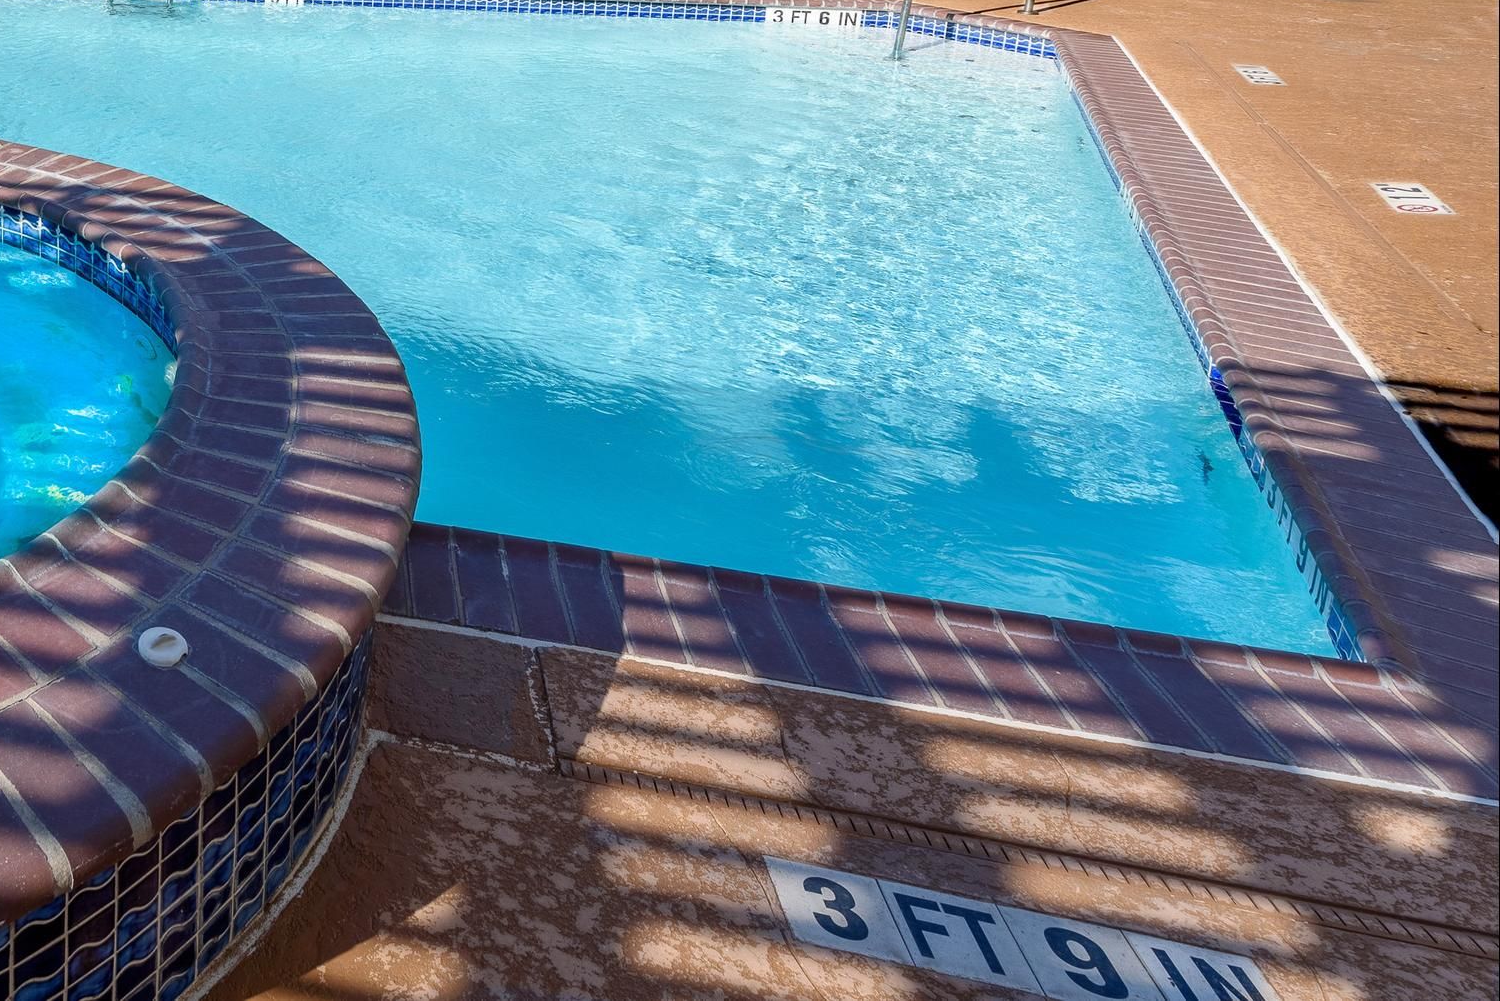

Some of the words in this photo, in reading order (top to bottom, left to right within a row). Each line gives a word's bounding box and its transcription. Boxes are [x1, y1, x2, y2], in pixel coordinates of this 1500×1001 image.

[772, 9, 784, 22] 3
[791, 10, 811, 24] FT
[819, 11, 831, 25] 6
[838, 11, 858, 26] IN
[1266, 485, 1278, 509] 3
[1296, 533, 1308, 573] 9
[1308, 565, 1329, 616] IN
[802, 875, 869, 941] 3
[893, 891, 1007, 976] FT
[1043, 926, 1131, 1000] 9
[1150, 947, 1280, 1001] IN
